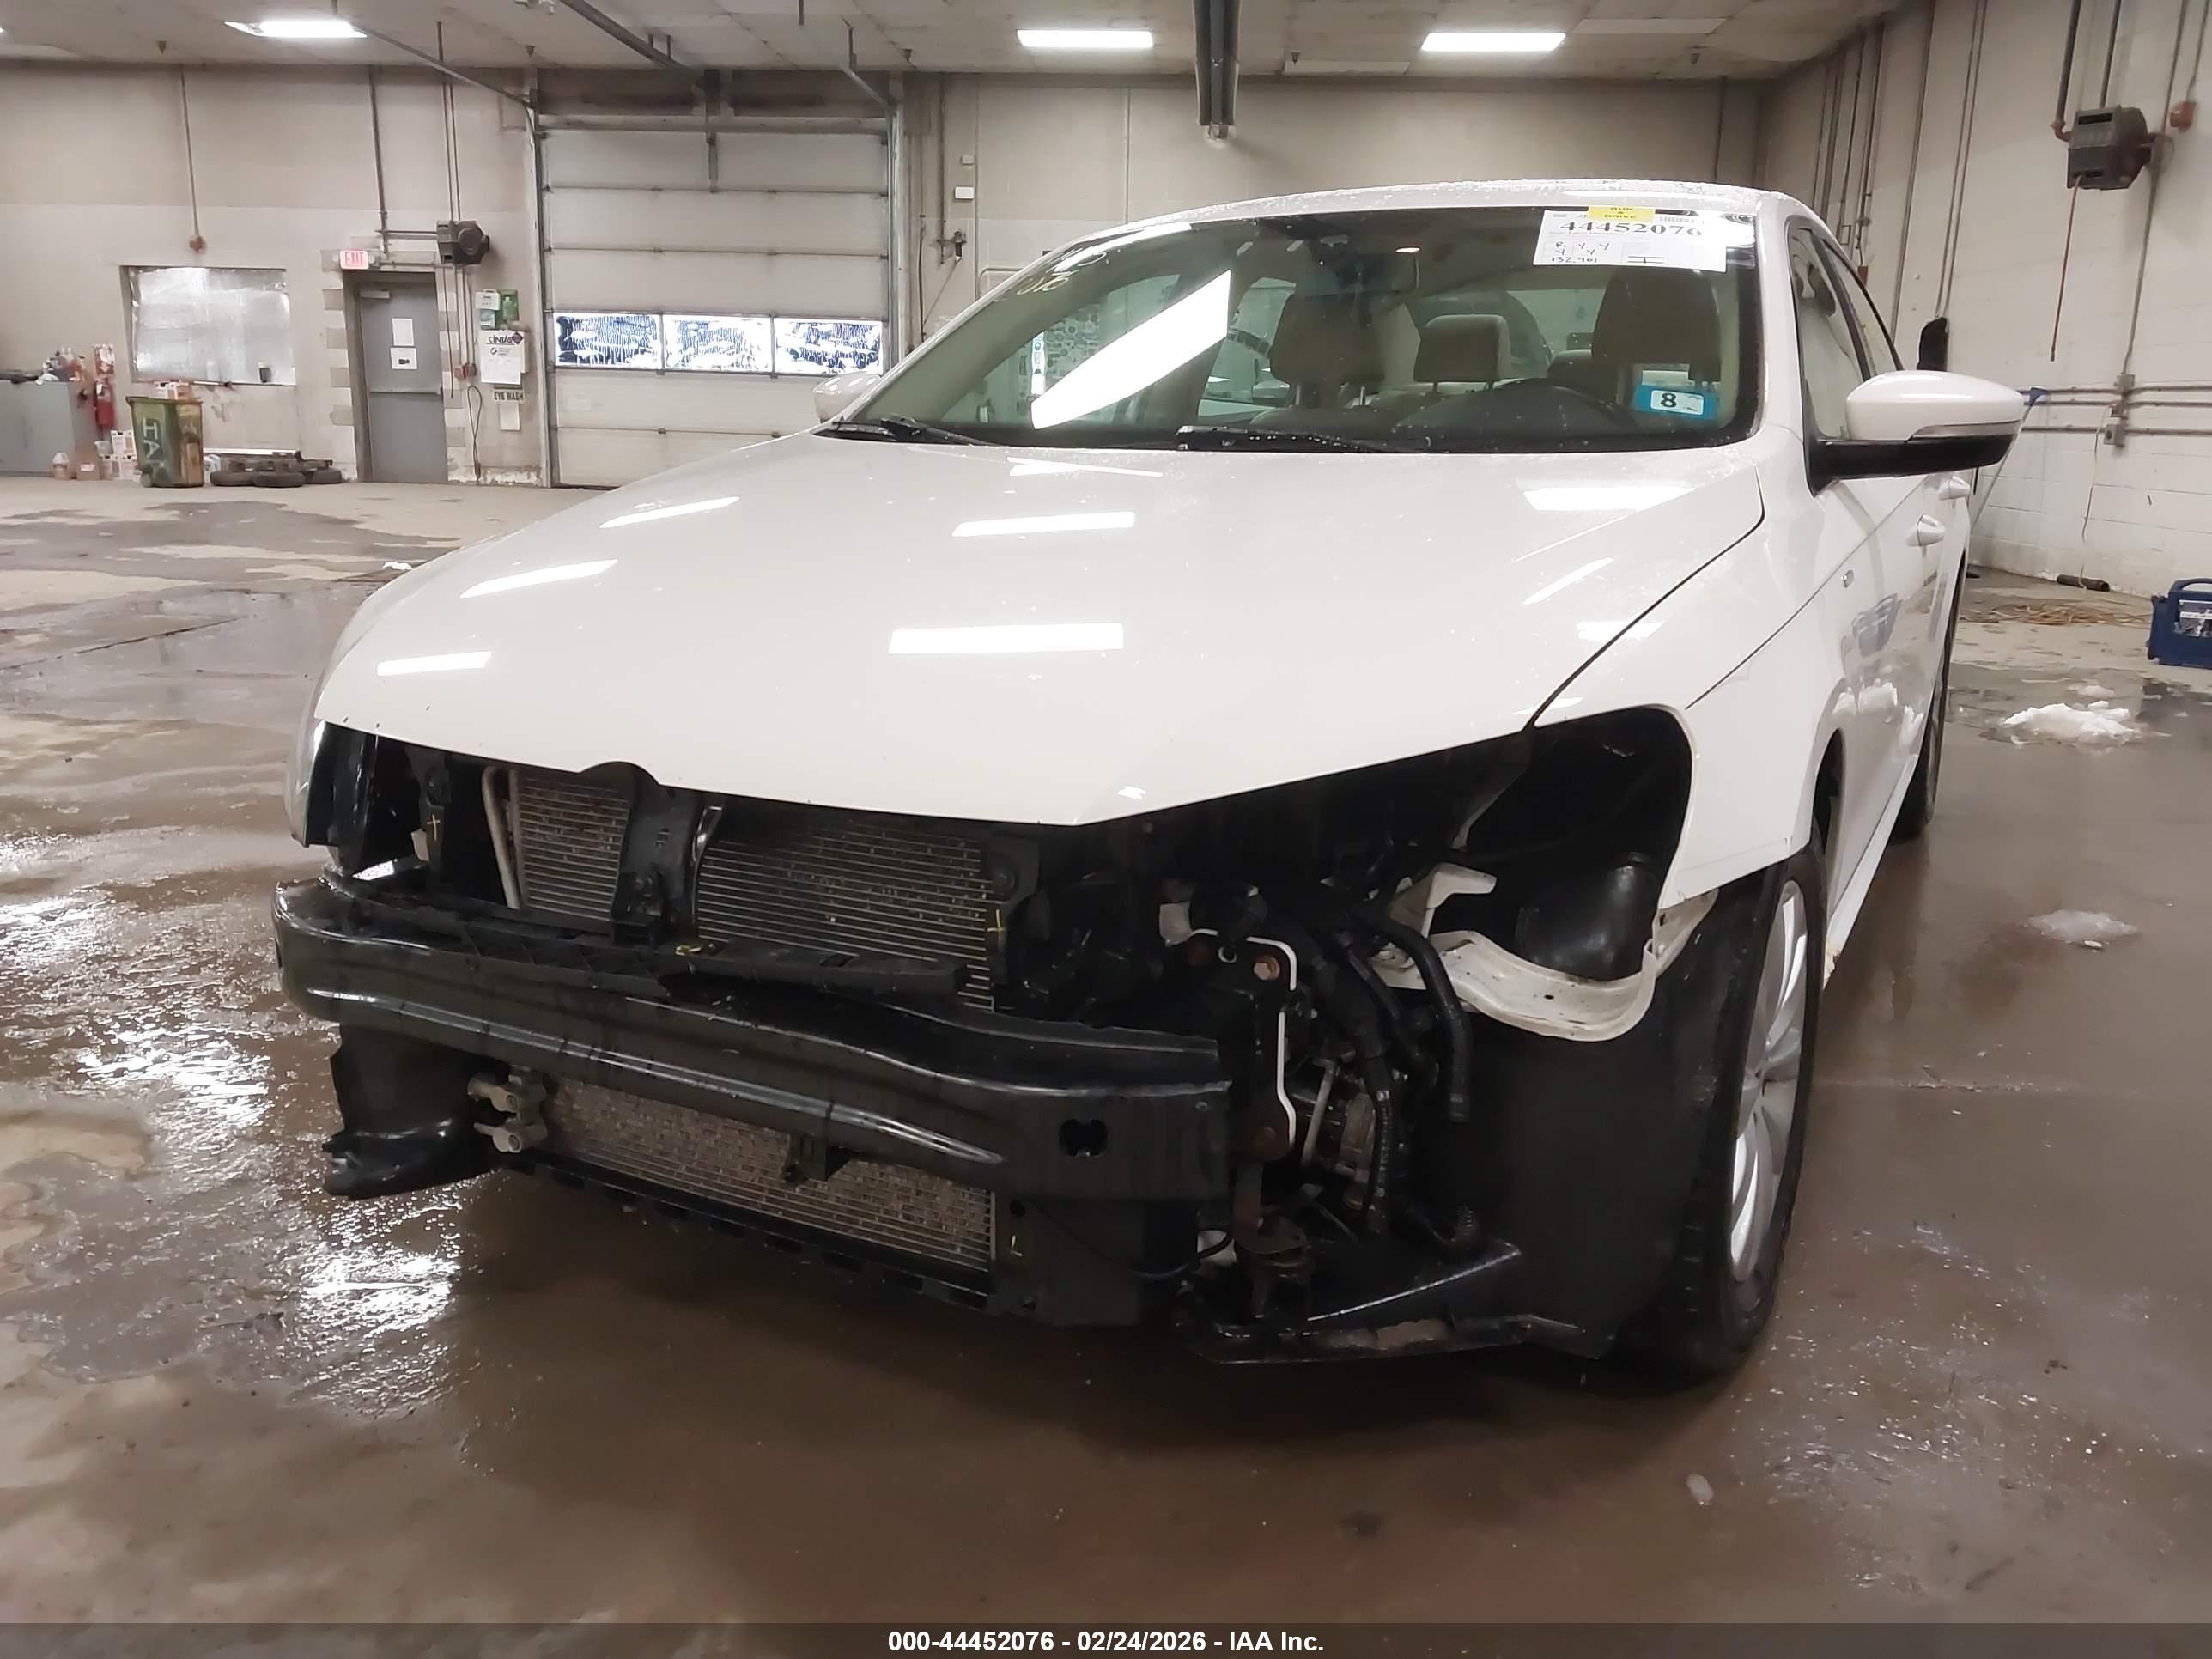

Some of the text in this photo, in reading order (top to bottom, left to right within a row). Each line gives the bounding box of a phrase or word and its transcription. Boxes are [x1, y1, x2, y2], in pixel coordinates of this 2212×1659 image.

[1560, 222, 1702, 236] 44452076
[345, 251, 364, 266] EXIT
[488, 335, 513, 343] CINTAS
[494, 391, 524, 401] EYE WASH
[1660, 392, 1677, 408] 8
